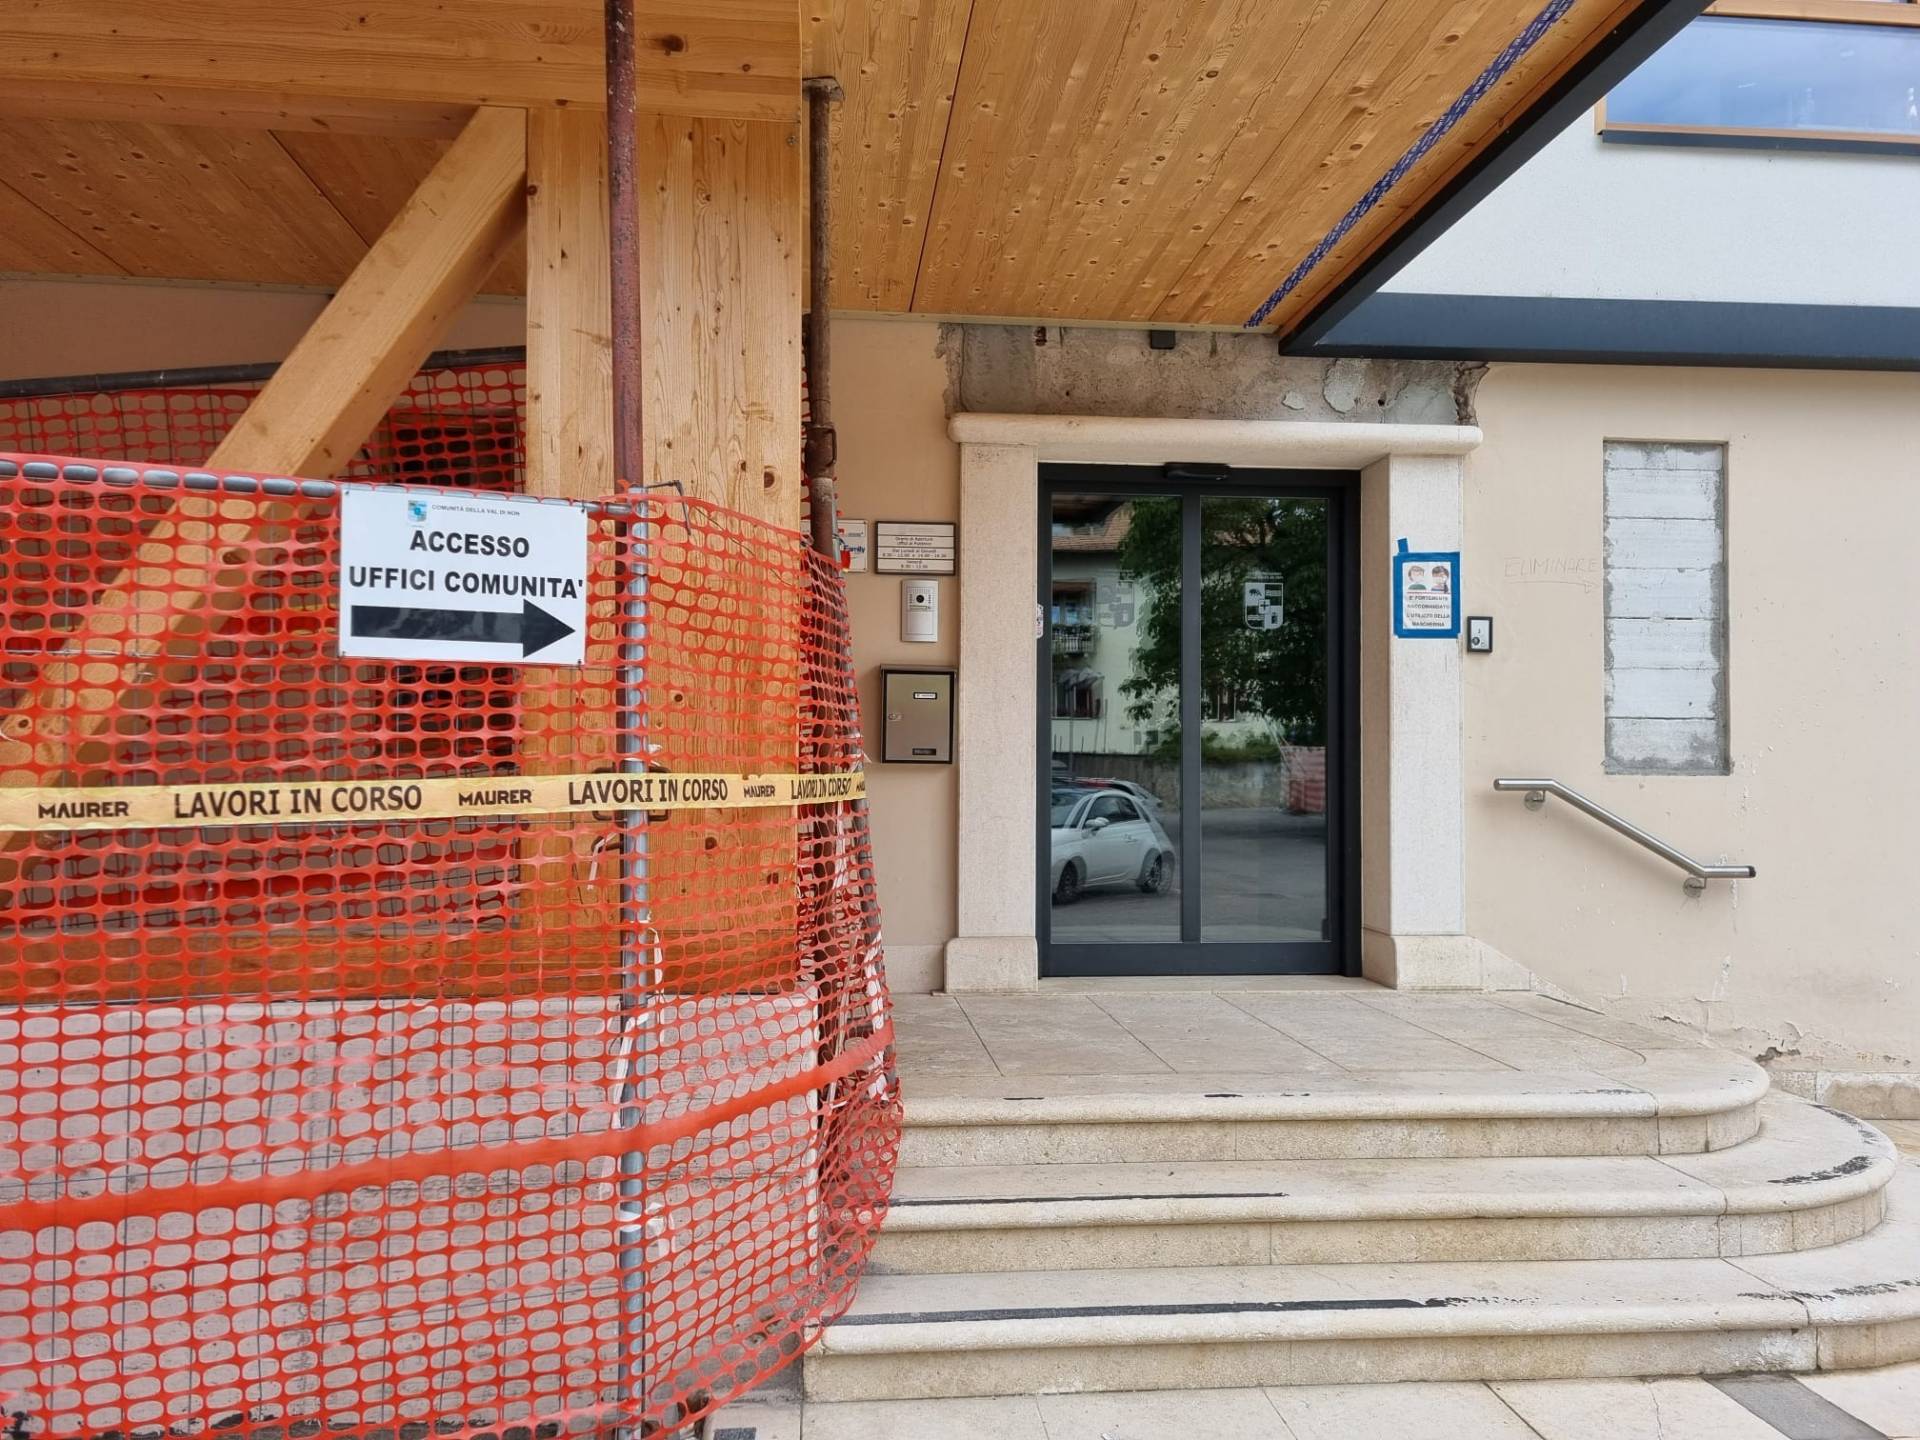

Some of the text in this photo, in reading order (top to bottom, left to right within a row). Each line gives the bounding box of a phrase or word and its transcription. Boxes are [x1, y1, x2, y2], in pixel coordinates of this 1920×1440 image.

[409, 529, 530, 558] ACCESSO
[349, 565, 583, 599] UFFICI COMUNITA'
[38, 801, 129, 819] MAURER
[174, 789, 281, 818] LAVORI
[290, 788, 322, 814] IN
[331, 785, 422, 812] CORSO
[458, 789, 532, 806] MAURER
[568, 778, 654, 805] LAVORI
[658, 778, 678, 802] IN
[682, 776, 728, 801] CORSO
[743, 784, 776, 799] MAURER
[791, 779, 817, 800] LAVORI
[818, 778, 827, 798] IN
[828, 777, 852, 797] CORSO
